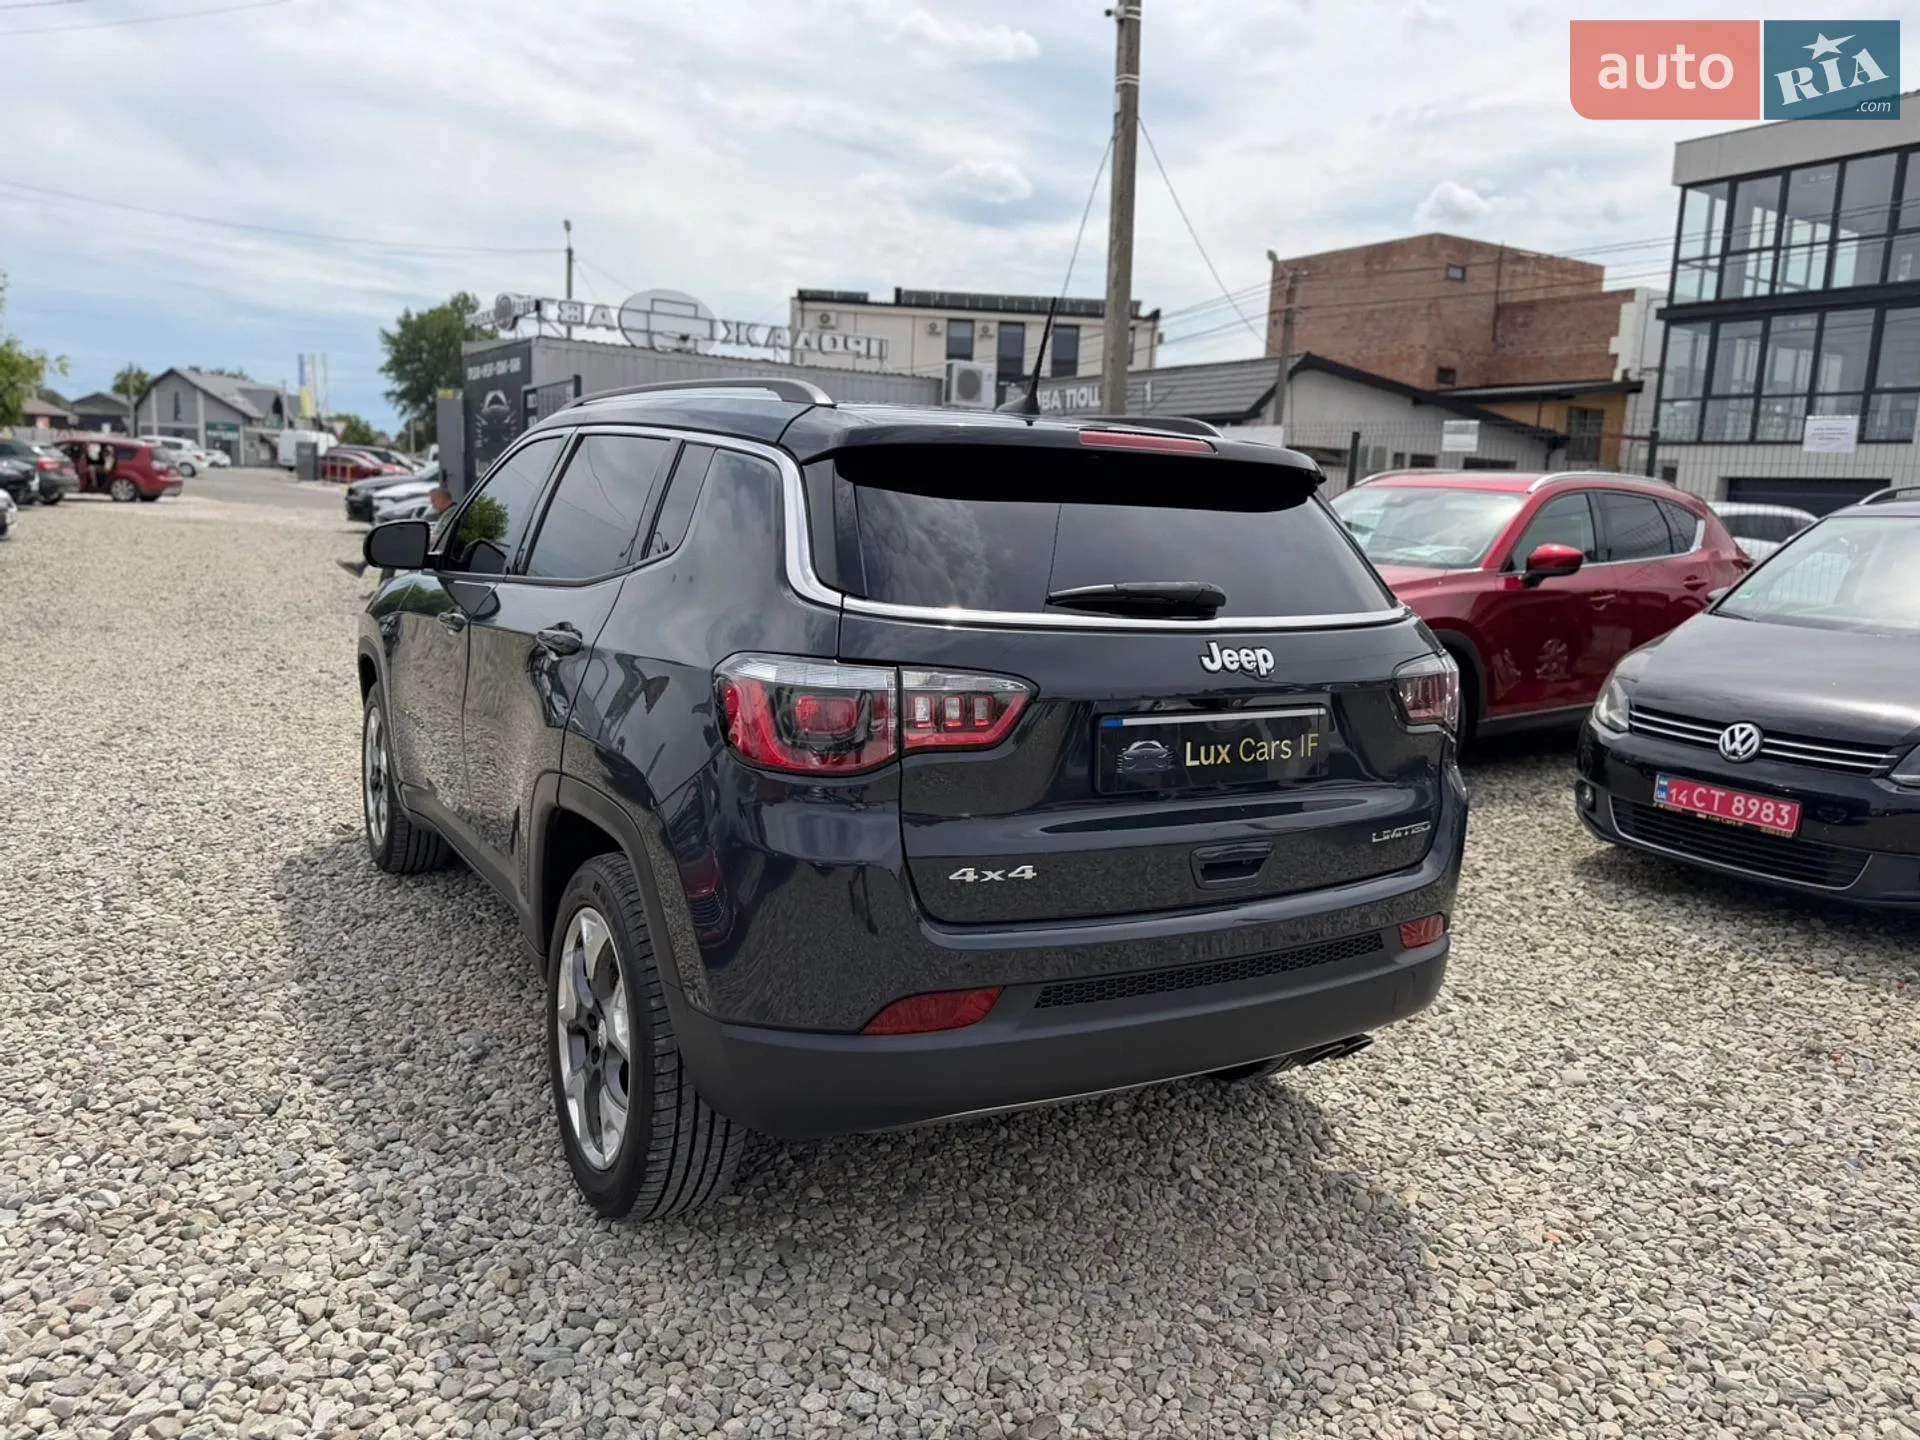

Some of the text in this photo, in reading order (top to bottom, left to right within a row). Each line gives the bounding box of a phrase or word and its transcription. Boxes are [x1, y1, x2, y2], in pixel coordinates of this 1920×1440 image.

[1200, 641, 1275, 676] Jeep
[1185, 733, 1320, 767] Lux Cars IF
[1669, 788, 1687, 804] 14
[1693, 787, 1726, 811] CT
[1731, 796, 1792, 826] 8983
